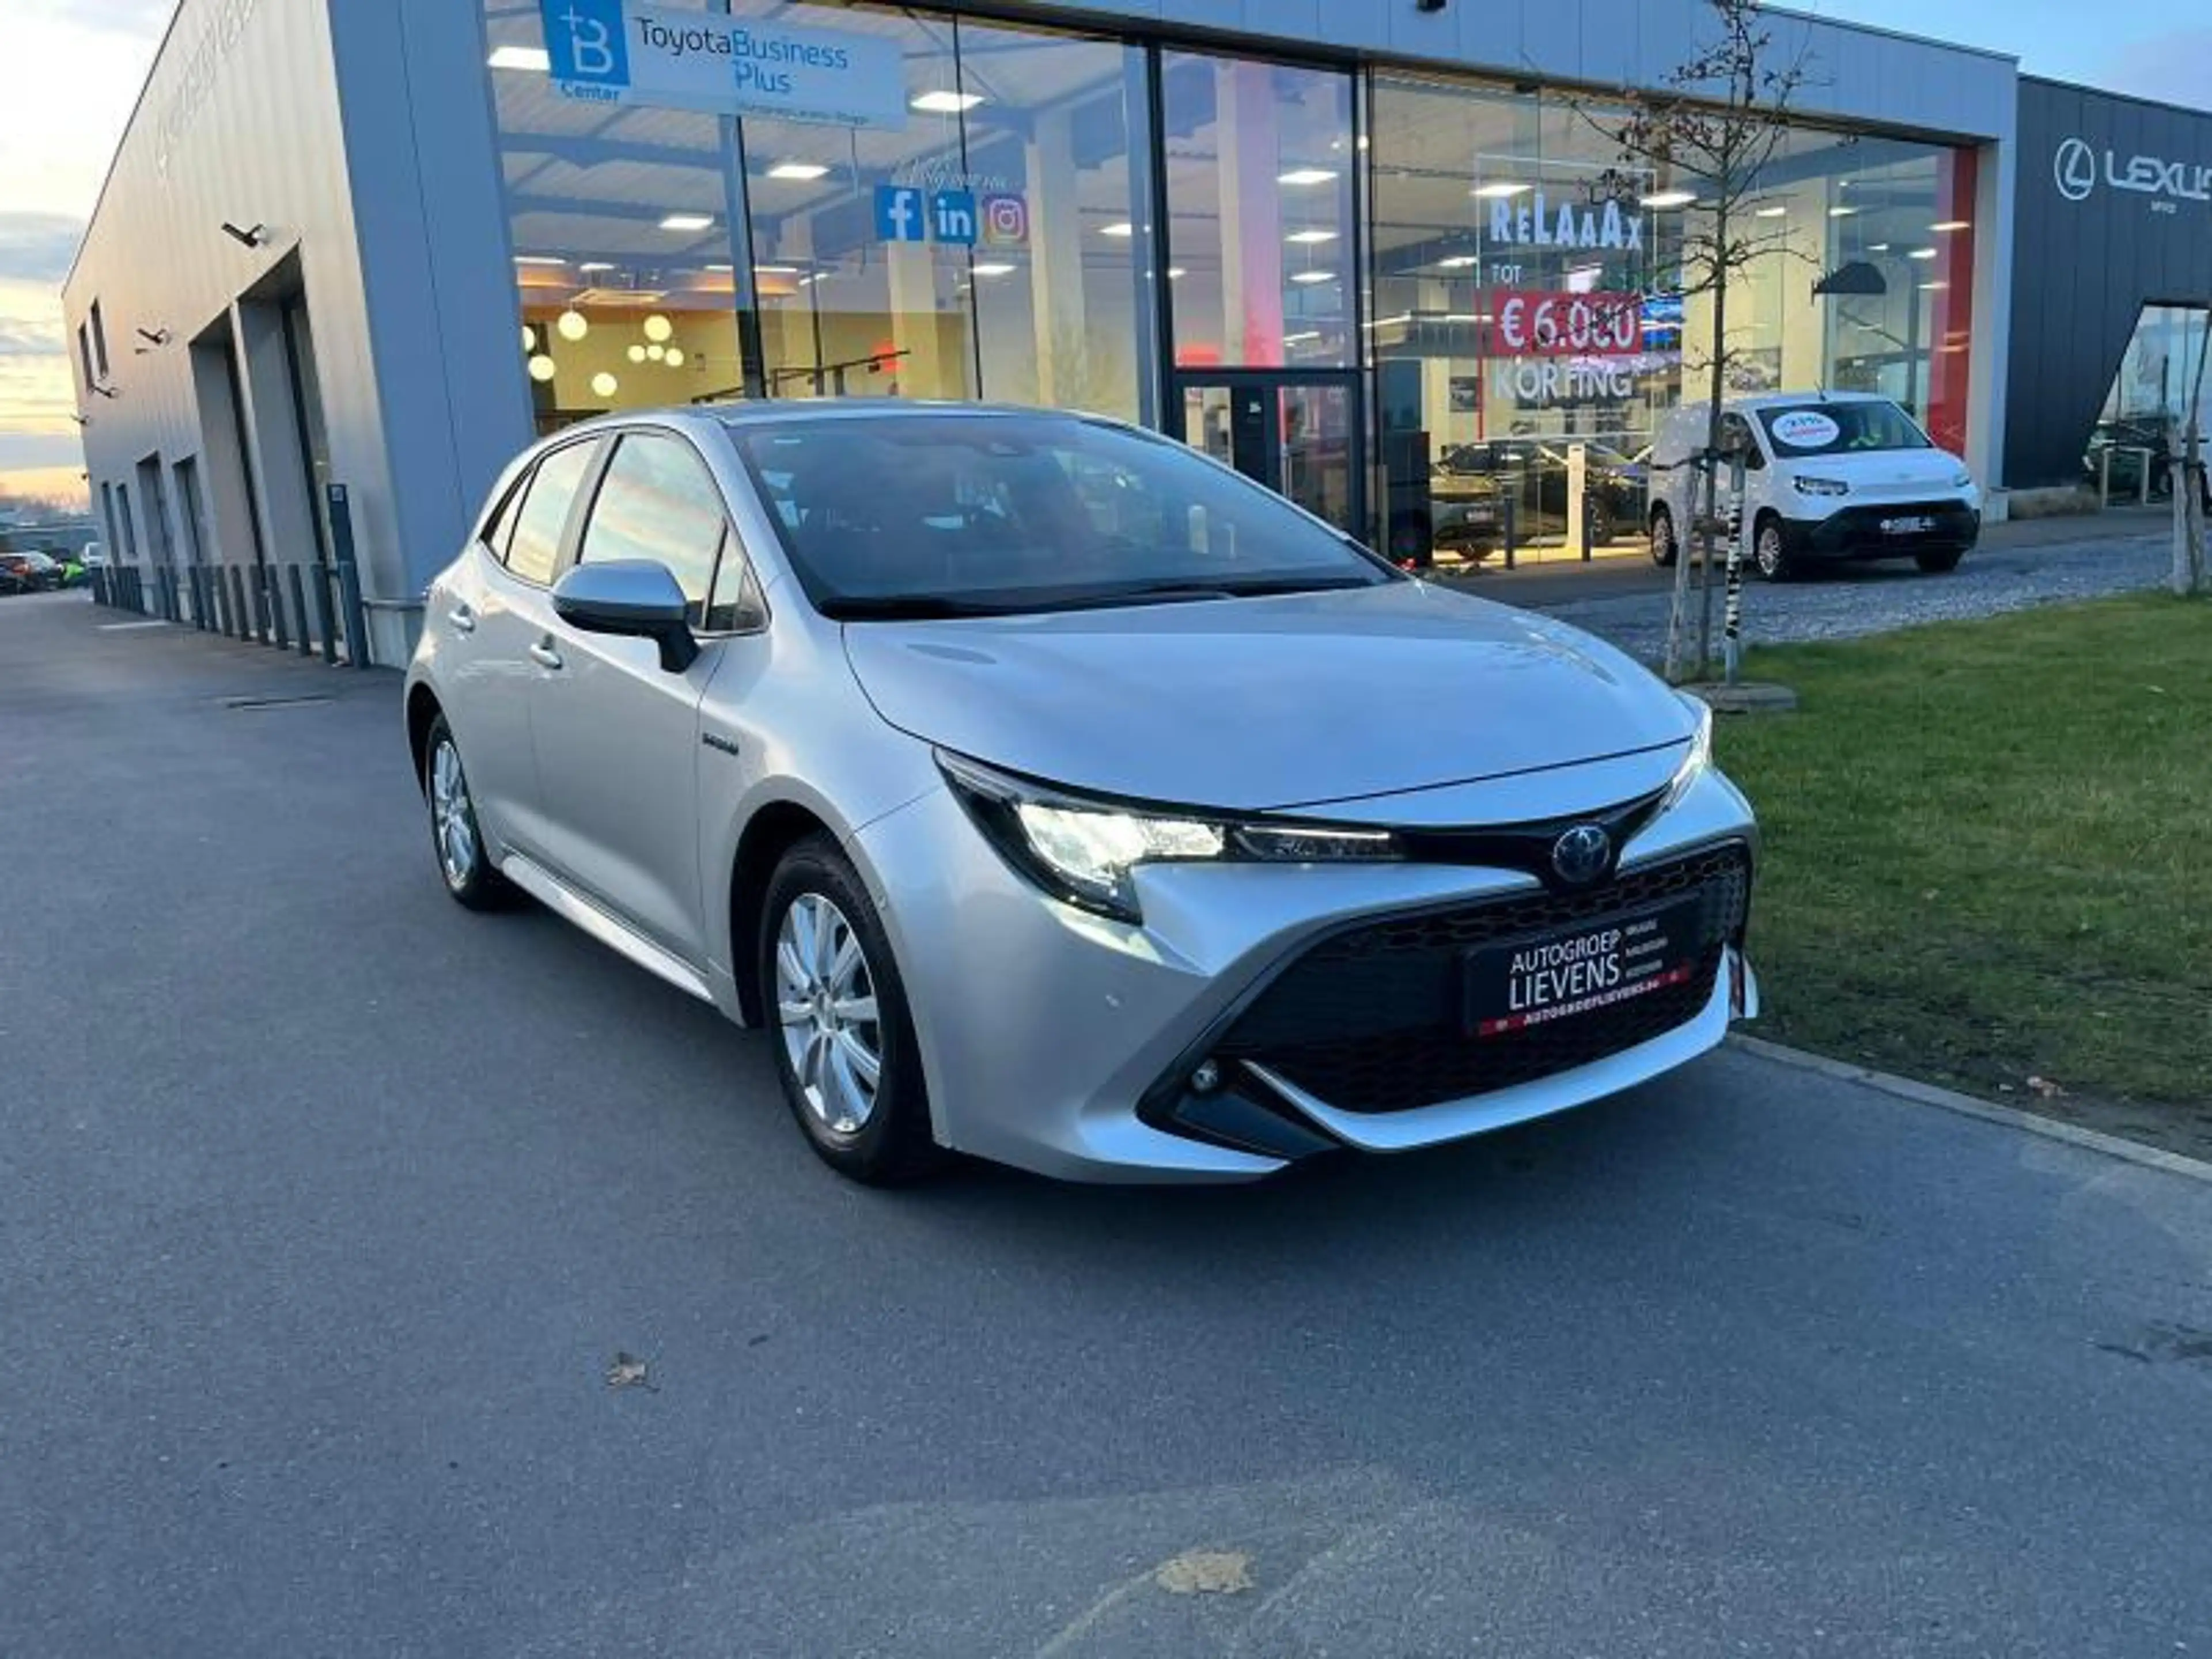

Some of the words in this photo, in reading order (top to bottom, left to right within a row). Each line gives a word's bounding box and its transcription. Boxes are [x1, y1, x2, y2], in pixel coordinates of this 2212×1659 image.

[731, 59, 793, 94] Plus
[1491, 263, 1522, 284] TOT
[1509, 929, 1621, 975] AUTOGROEP
[1509, 954, 1620, 1010] LIEVENS
